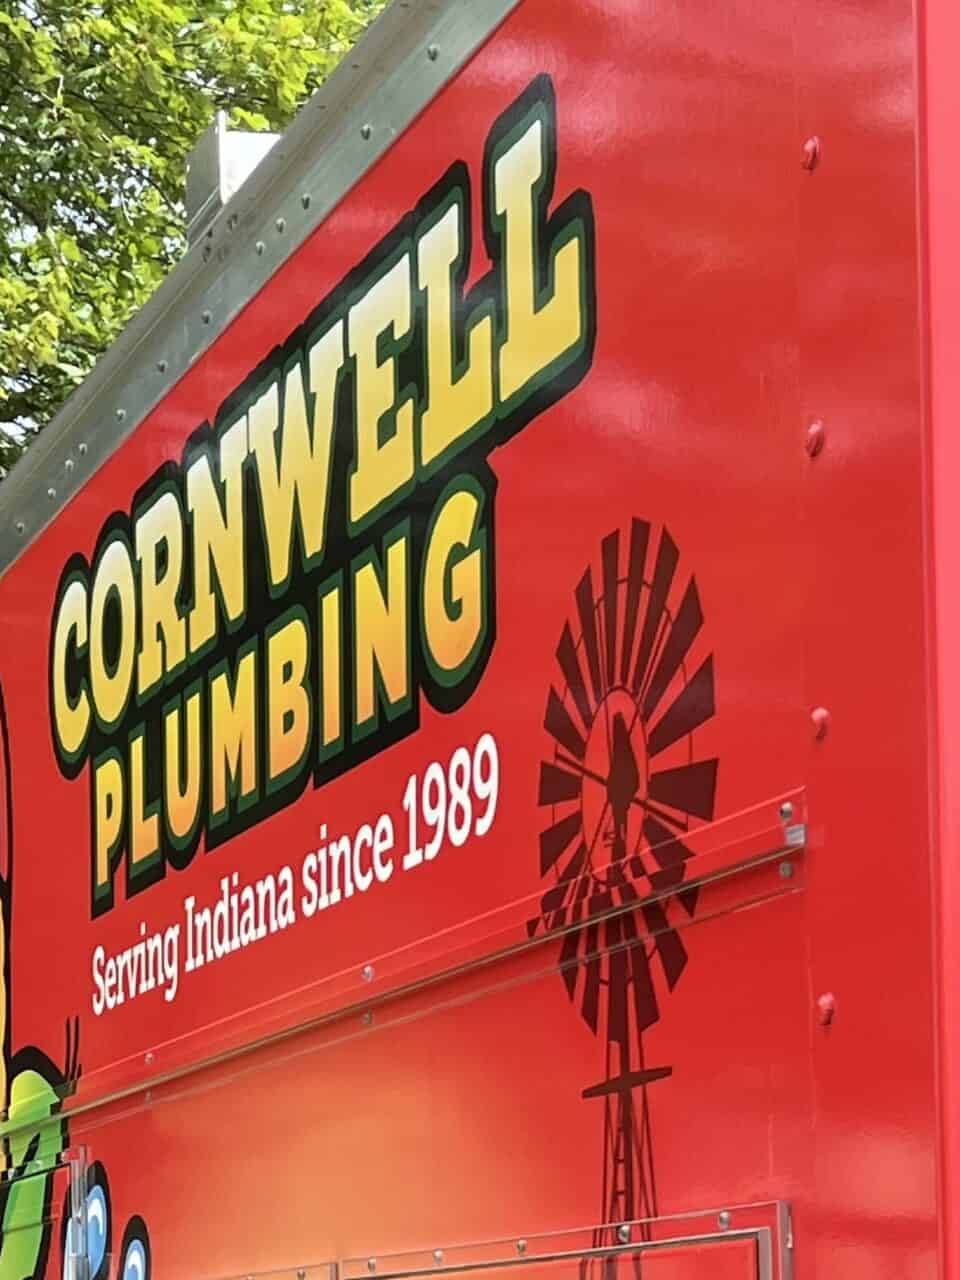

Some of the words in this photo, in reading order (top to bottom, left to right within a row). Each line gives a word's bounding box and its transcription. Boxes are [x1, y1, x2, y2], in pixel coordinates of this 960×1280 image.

[51, 117, 582, 755] CORNWELL
[91, 921, 181, 1016] Serving
[184, 865, 297, 973] Indiana
[301, 813, 395, 918] since
[402, 732, 500, 872] 1989
[94, 489, 483, 888] PLUMBING
